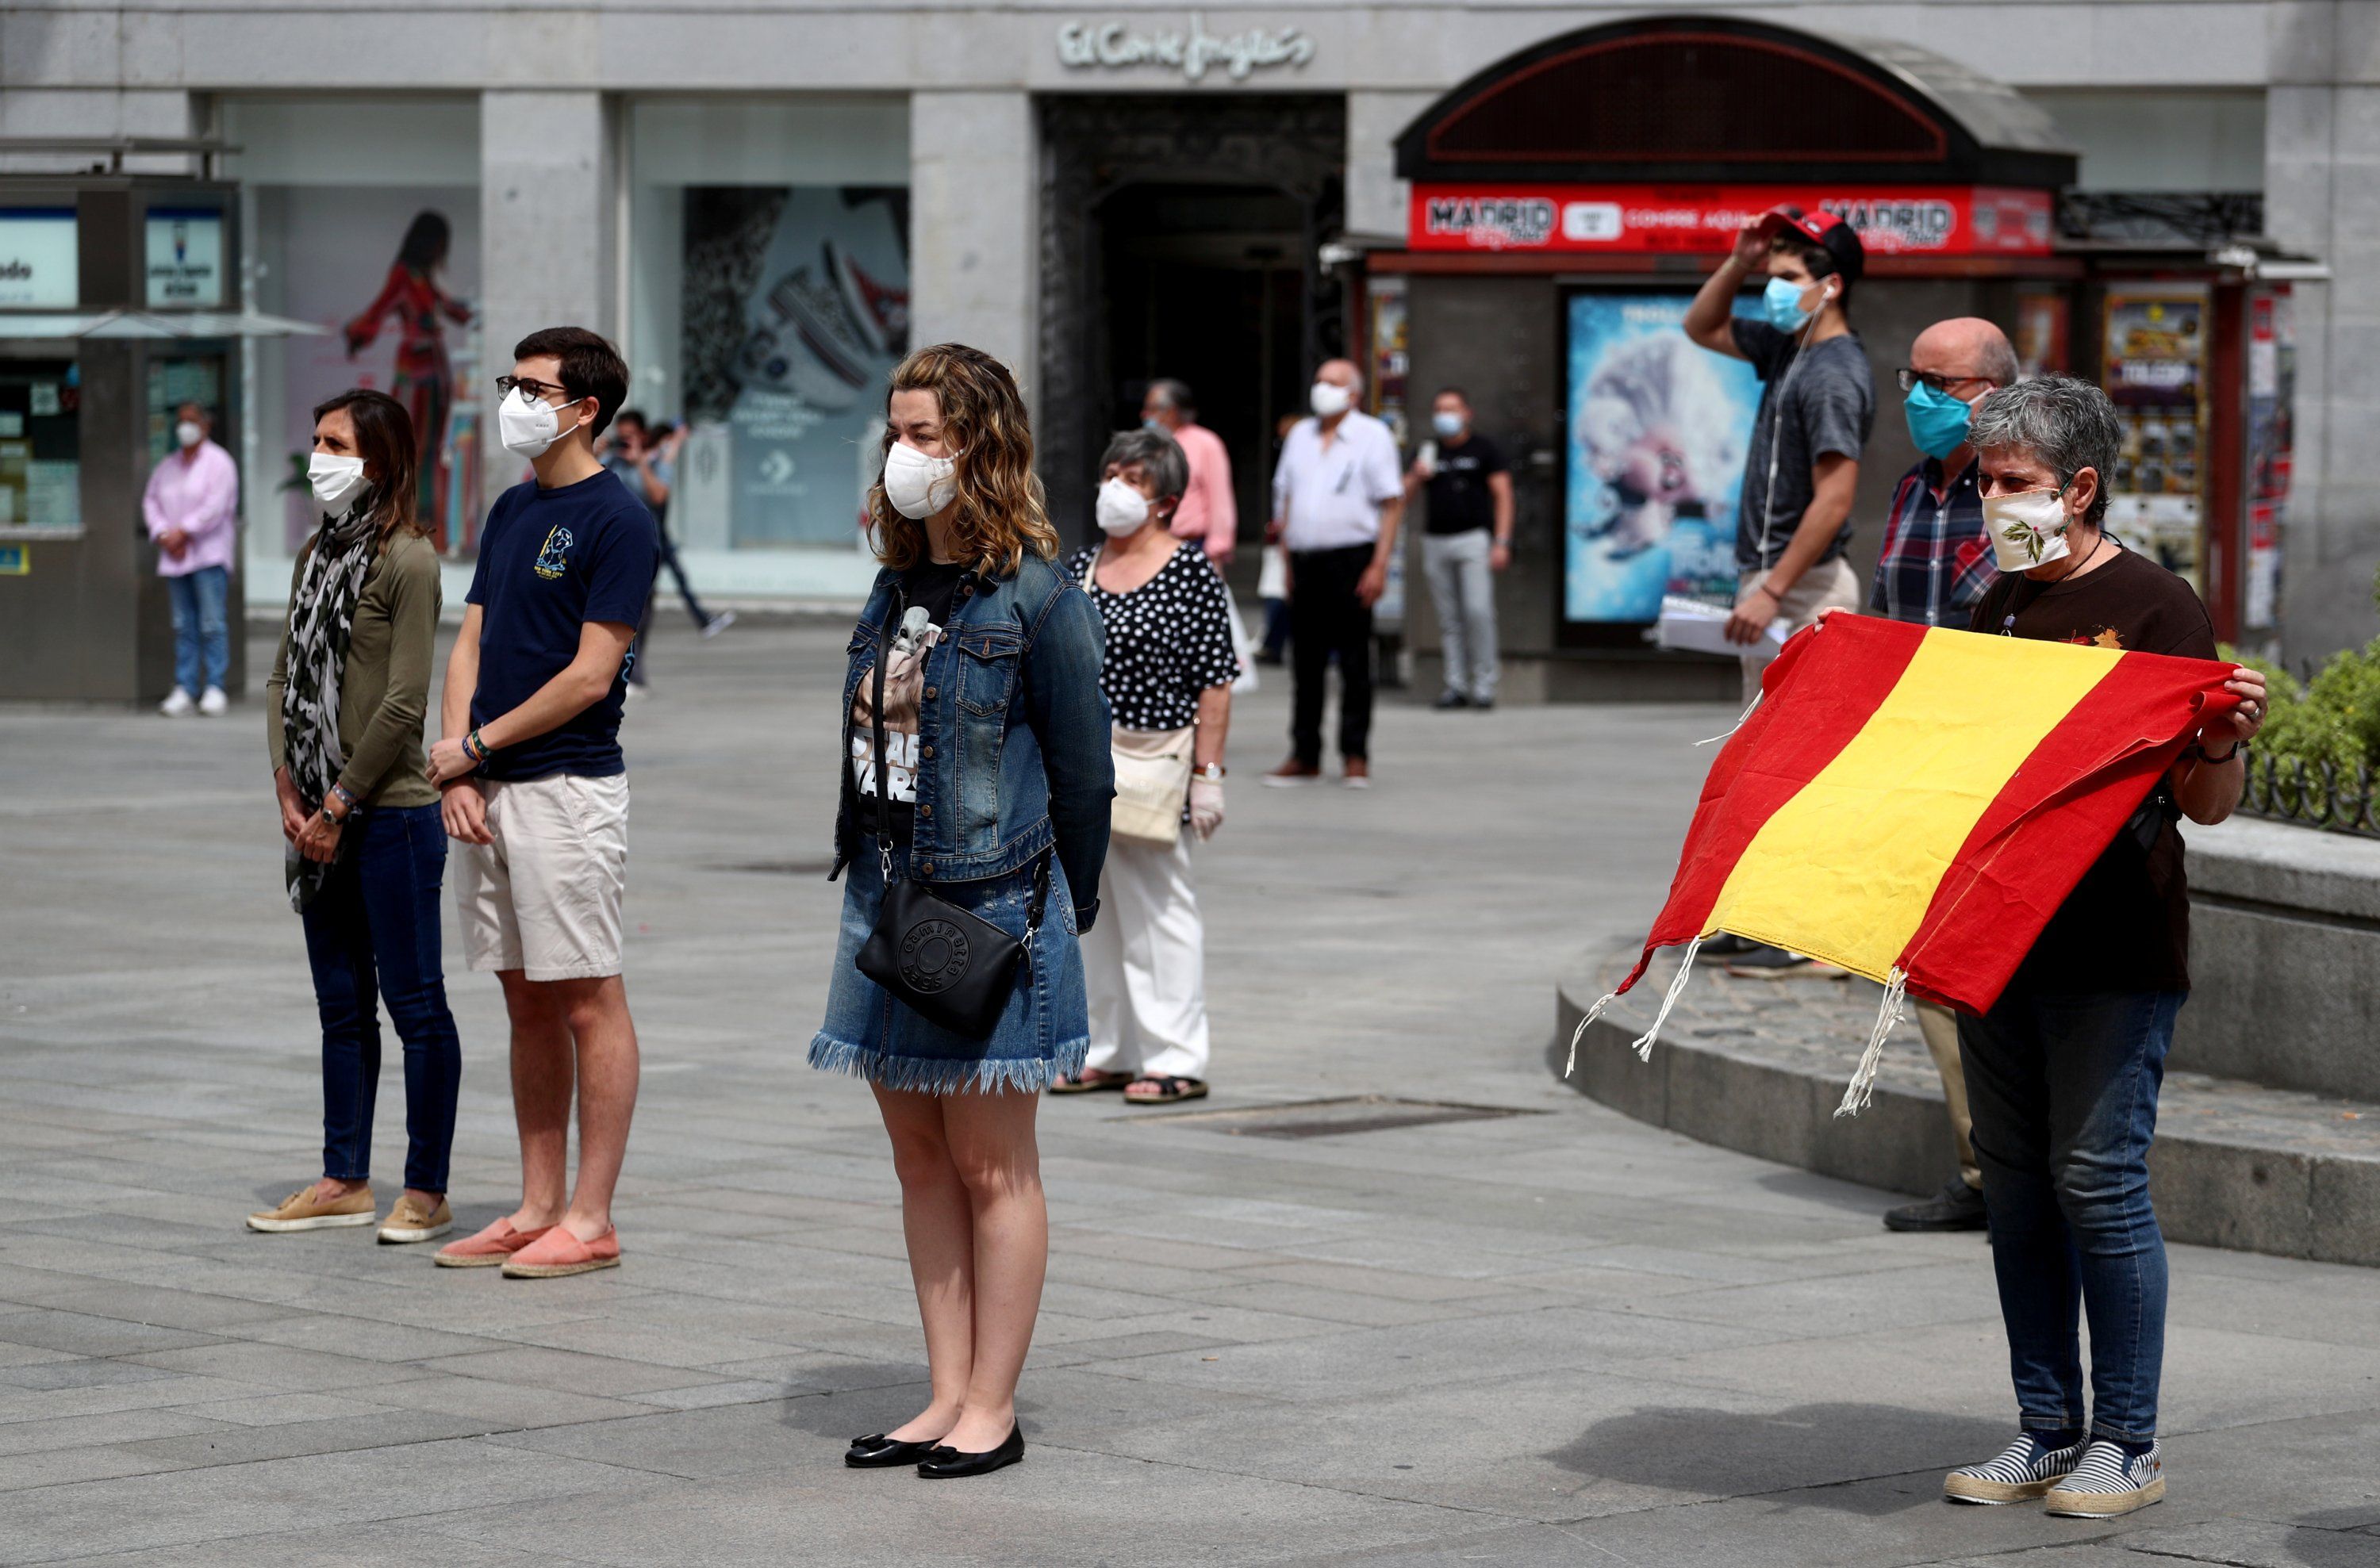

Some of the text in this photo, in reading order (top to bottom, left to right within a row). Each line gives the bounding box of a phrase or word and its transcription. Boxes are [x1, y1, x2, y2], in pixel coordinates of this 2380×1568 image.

[1428, 198, 1557, 232] MADRID
[851, 725, 920, 768] SAR
[903, 963, 942, 990] bags
